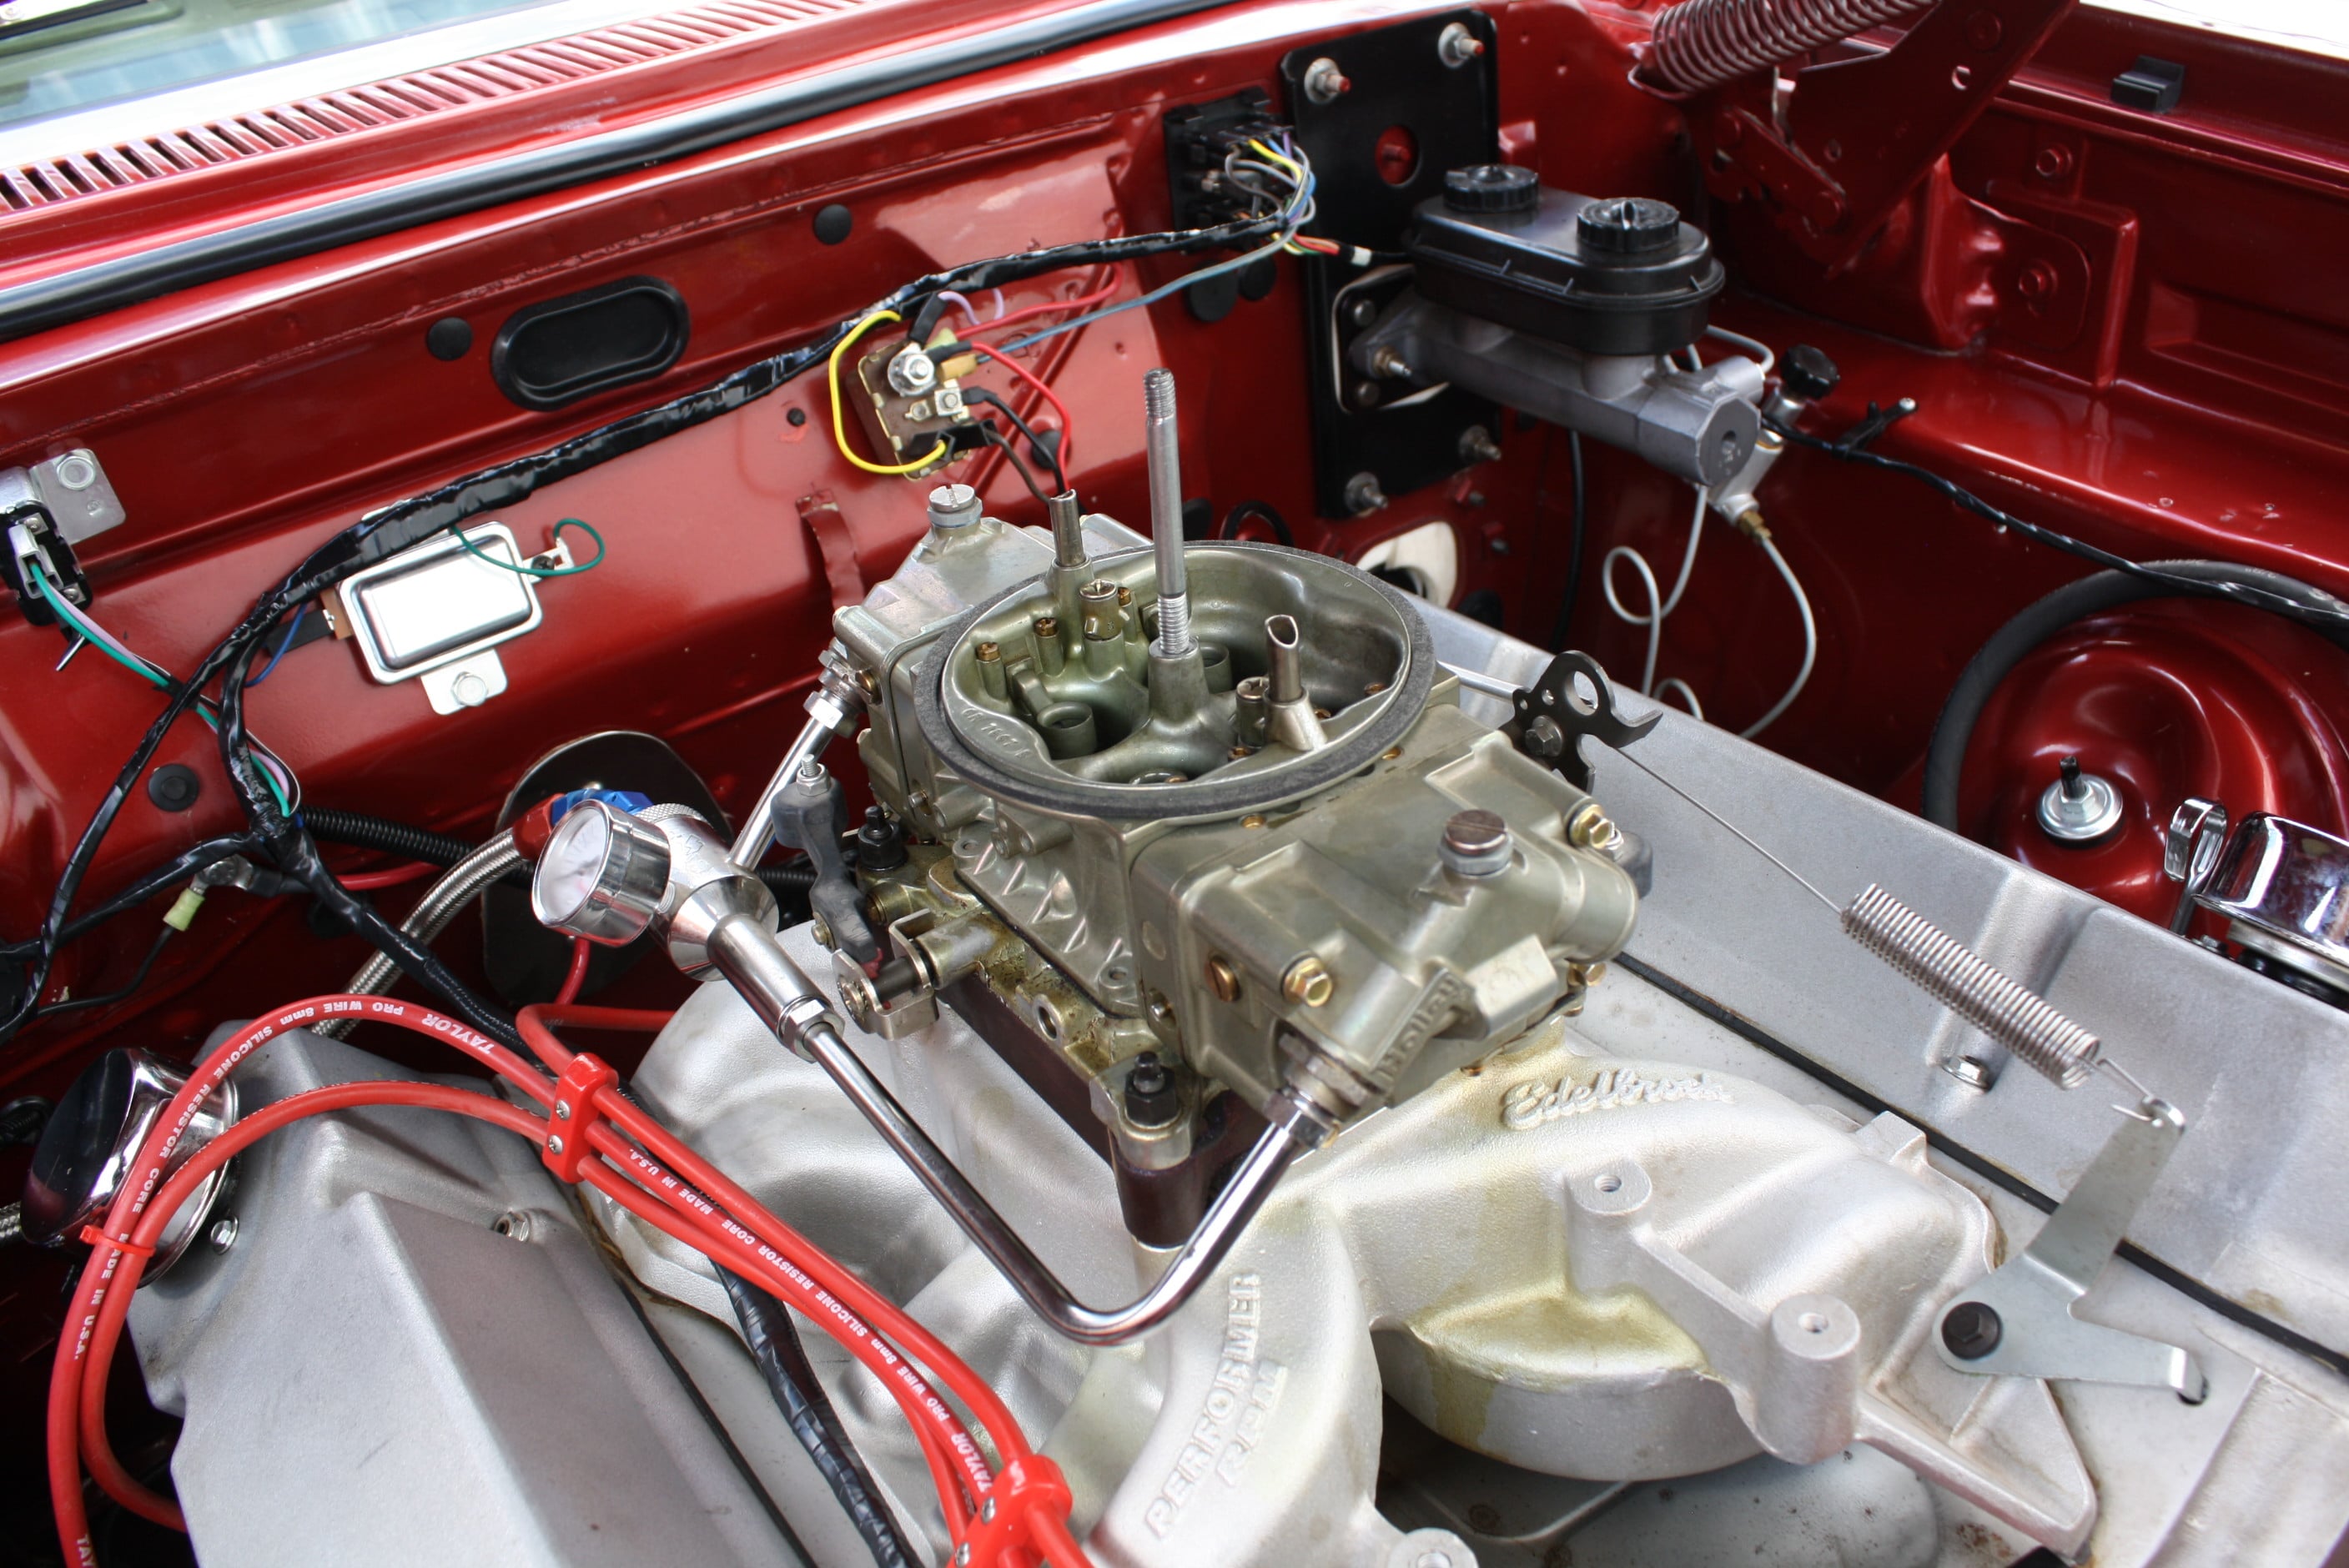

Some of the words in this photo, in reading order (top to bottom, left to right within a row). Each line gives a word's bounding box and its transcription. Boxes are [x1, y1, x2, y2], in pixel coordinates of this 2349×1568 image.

[280, 1007, 314, 1025] 8mm
[324, 1001, 362, 1013] WIRE
[373, 1003, 404, 1015] PRO
[1374, 971, 1461, 1083] Holley
[214, 1026, 273, 1079] SILICONE
[422, 1013, 494, 1053] TAYLOR
[1501, 1067, 1735, 1132] Edelbrock
[159, 1083, 211, 1158] RESISTOR
[629, 1148, 660, 1175] U.S.A.
[132, 1168, 159, 1214] CORE
[661, 1176, 678, 1189] IN
[678, 1189, 714, 1215] MADE
[721, 1219, 756, 1245] CORE
[757, 1245, 815, 1290] RESISTOR
[91, 1289, 105, 1305] IN
[815, 1290, 868, 1337] SILICONE
[74, 1315, 94, 1360] U.S.A.
[871, 1339, 898, 1364] 8mm
[897, 1365, 927, 1395] WIRE
[927, 1397, 950, 1422] PRO
[1144, 1273, 1260, 1540] PERFORMER
[1215, 1359, 1288, 1487] RPM
[951, 1432, 993, 1493] TAYLOR
